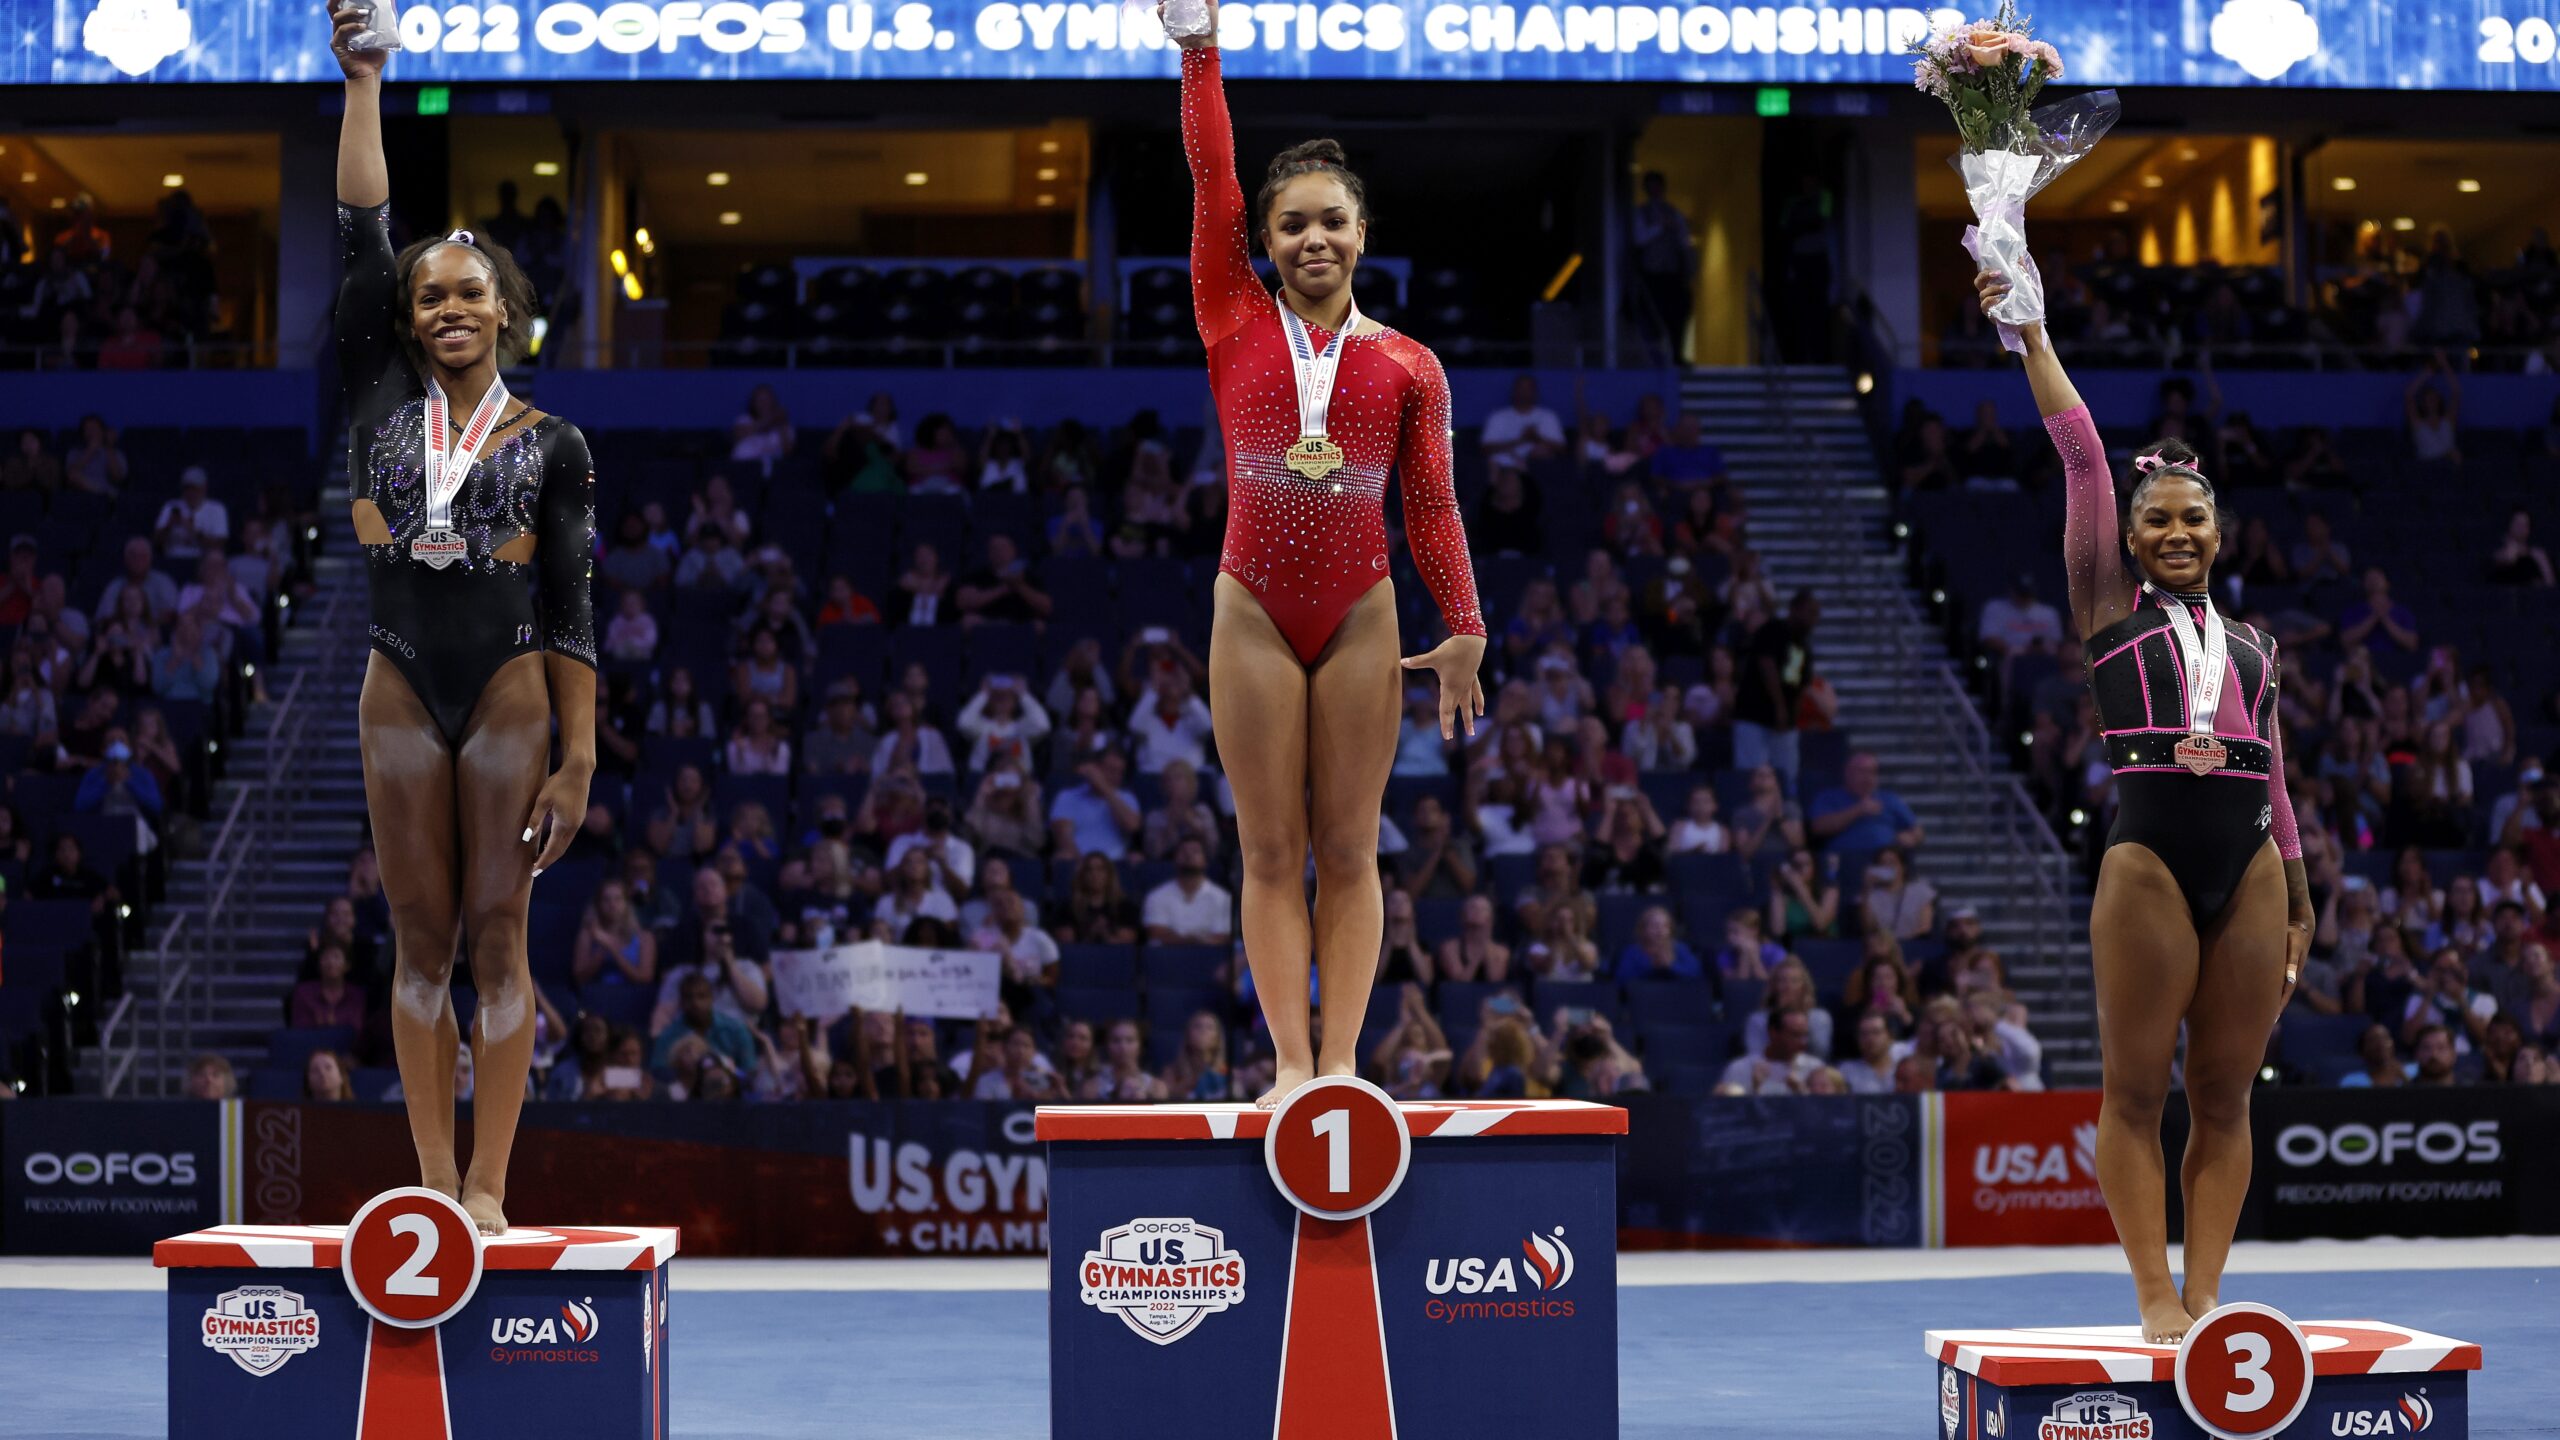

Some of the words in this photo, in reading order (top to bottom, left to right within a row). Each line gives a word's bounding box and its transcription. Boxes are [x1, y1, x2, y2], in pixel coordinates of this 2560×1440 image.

[534, 2, 807, 53] OOFOS
[826, 4, 955, 51] U.S.
[974, 3, 1405, 52] GYMNSTICS
[1314, 379, 1326, 401] 2022
[1288, 452, 1341, 462] GYMNASTICS
[413, 541, 465, 552] GYMNASTICS
[2203, 681, 2215, 702] 2022
[2177, 747, 2226, 758] GYMNASTICS
[1311, 1109, 1350, 1193] 1
[2276, 1120, 2502, 1167] OOFOS
[24, 1151, 197, 1186] OOFOS
[848, 1132, 940, 1214] U.S.
[1863, 1102, 1911, 1243] 2022
[1974, 1143, 2070, 1184] USA
[2277, 1183, 2385, 1204] RECOVERY
[2388, 1180, 2503, 1202] FOOTWEAR
[25, 1198, 107, 1214] RECOVERY
[110, 1198, 198, 1214] FOOTWEAR
[1134, 1223, 1191, 1233] OOFOS
[385, 1213, 440, 1297] 2
[1139, 1238, 1187, 1266] U.S.
[1085, 1260, 1240, 1288] GYMNASTICS
[1425, 1257, 1518, 1295] USA
[240, 1289, 281, 1297] OOFOS
[1098, 1289, 1227, 1300] CHAMPIONSHIPS
[245, 1300, 278, 1320] U.S.
[1149, 1302, 1176, 1311] 2022
[1425, 1297, 1575, 1324] Gymnastics
[206, 1316, 316, 1336] GYMNASTICS
[491, 1317, 558, 1344] USA
[215, 1336, 306, 1345] CHAMPIONSHIPS
[251, 1345, 271, 1353] 2022
[490, 1347, 599, 1365] Gymnastics
[2224, 1331, 2275, 1413] 3
[2075, 1393, 2116, 1403] OOFOS
[2042, 1419, 2150, 1440] GYMNASTICS
[2331, 1409, 2395, 1437] USA
